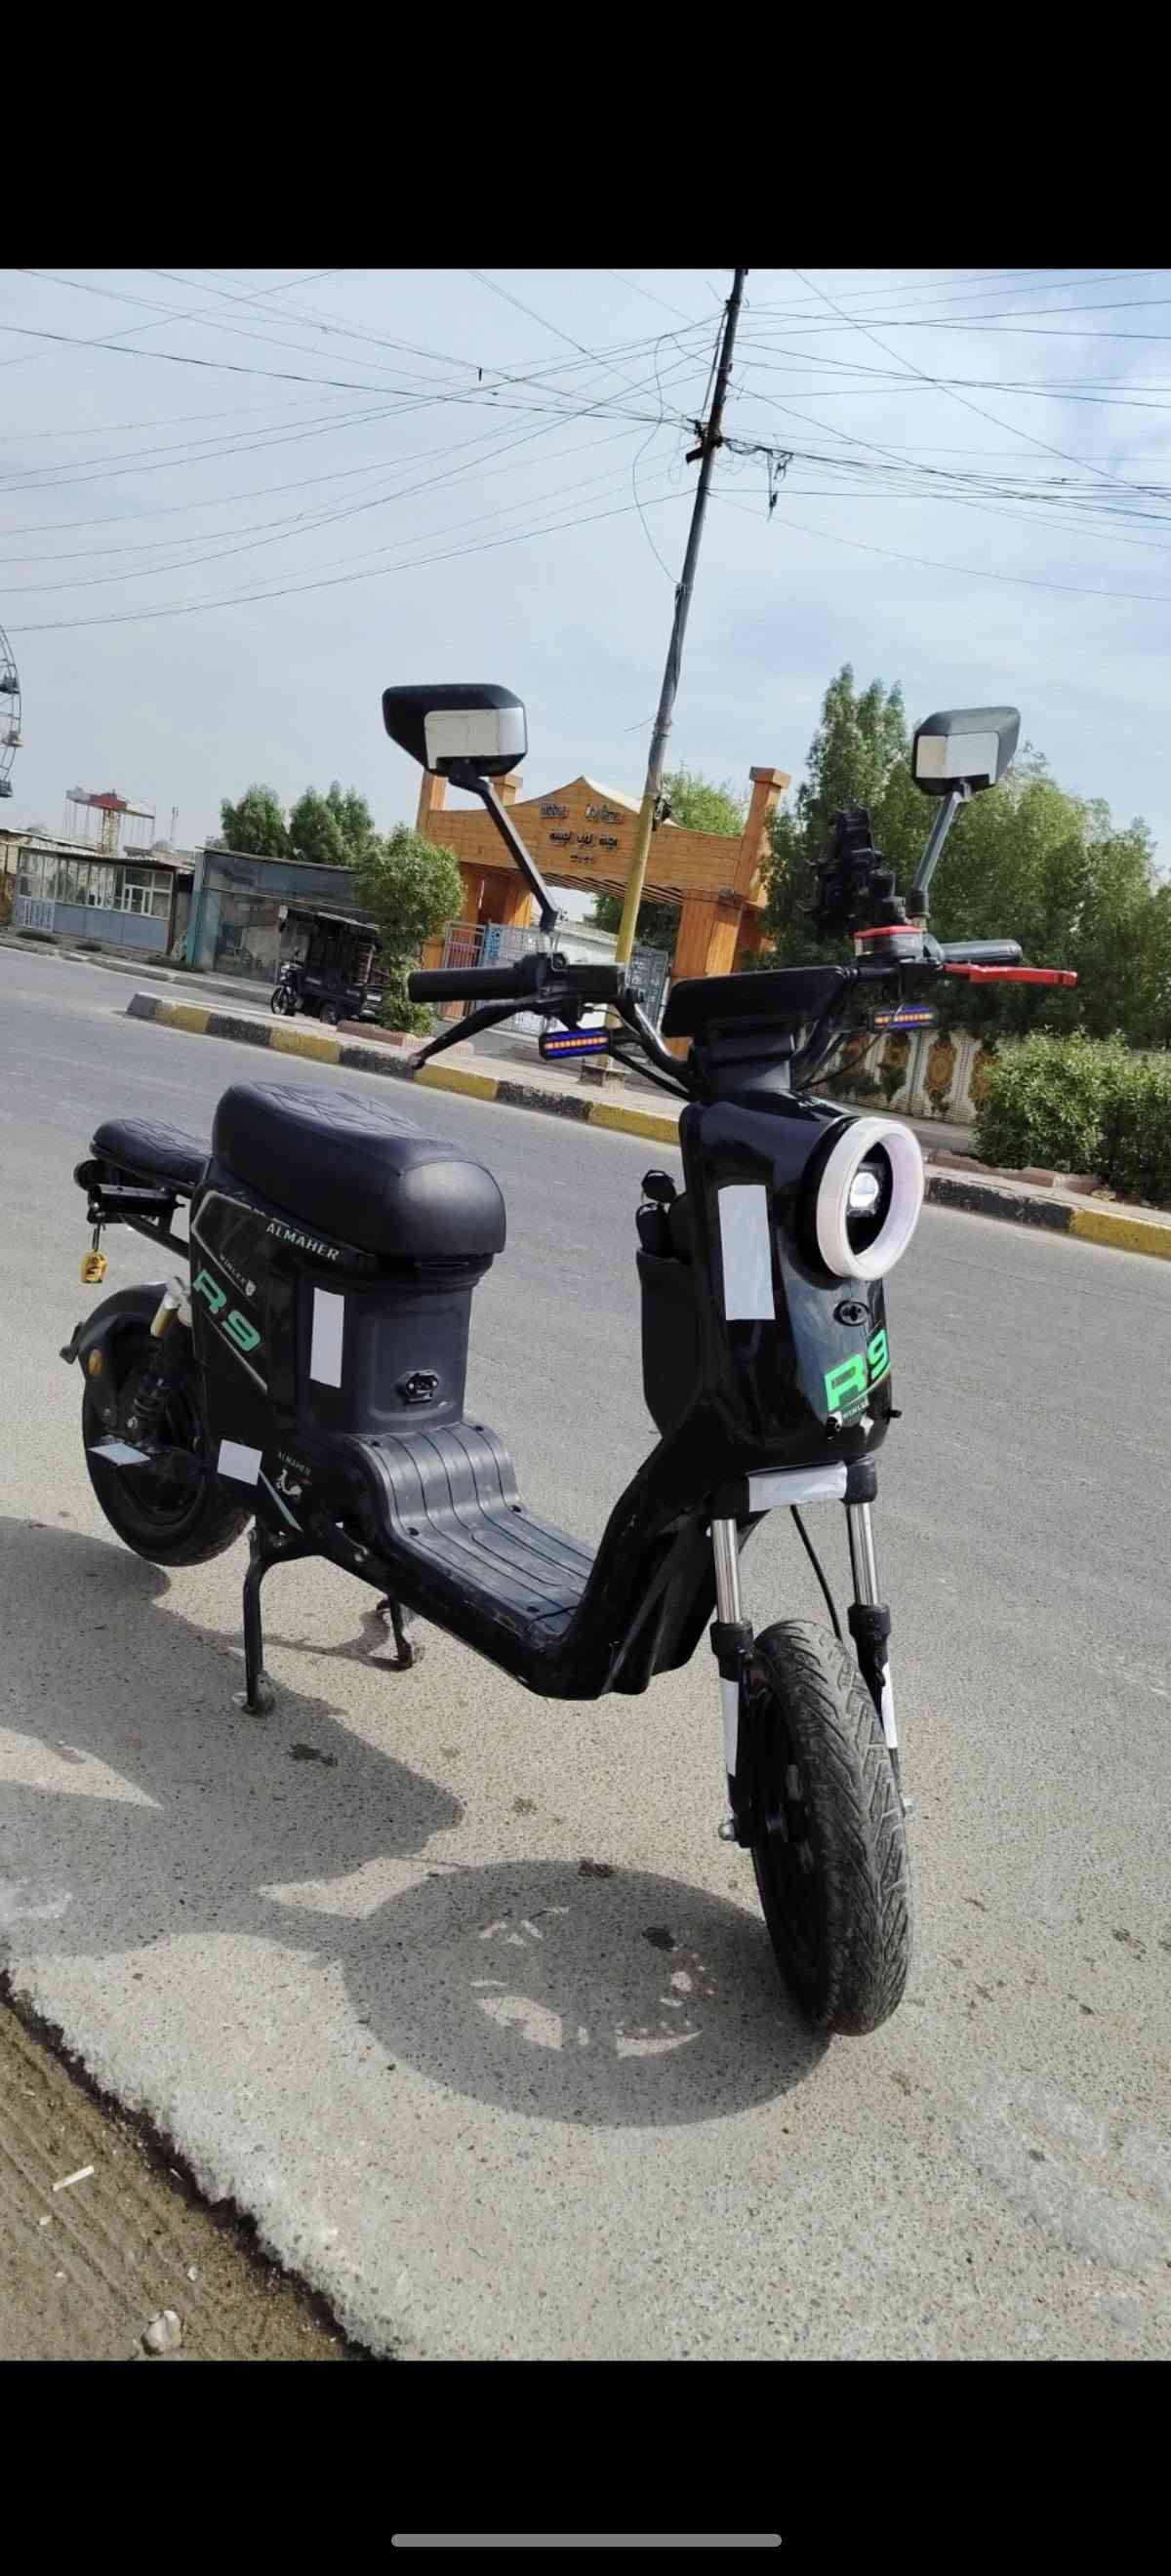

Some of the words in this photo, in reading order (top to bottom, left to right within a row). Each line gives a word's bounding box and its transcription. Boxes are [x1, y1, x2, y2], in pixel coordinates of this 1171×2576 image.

[265, 1223, 340, 1261] ALMAHER
[192, 1269, 262, 1351] R9
[824, 1329, 889, 1412] R9
